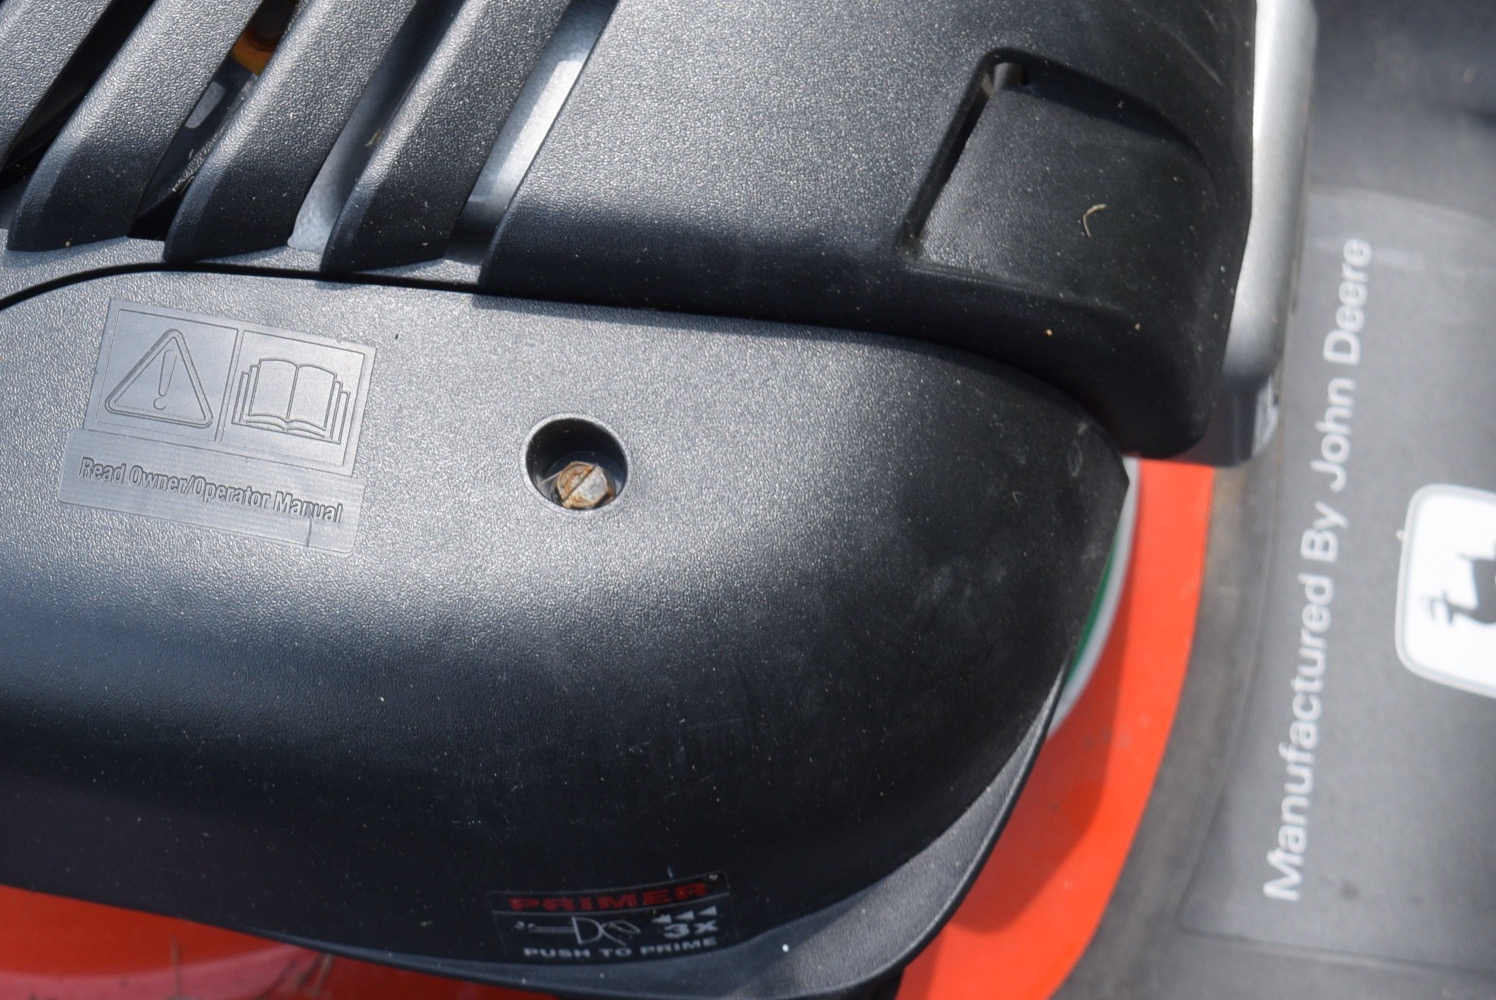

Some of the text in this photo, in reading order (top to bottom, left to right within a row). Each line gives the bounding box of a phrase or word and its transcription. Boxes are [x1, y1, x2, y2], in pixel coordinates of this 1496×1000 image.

[77, 456, 344, 525] Read Owner/Operator Manual
[1262, 237, 1374, 901] Manufactured By John Deere
[508, 881, 710, 912] PRIMER
[662, 919, 720, 939] 3X
[522, 936, 719, 959] PUSH TO PRIME
